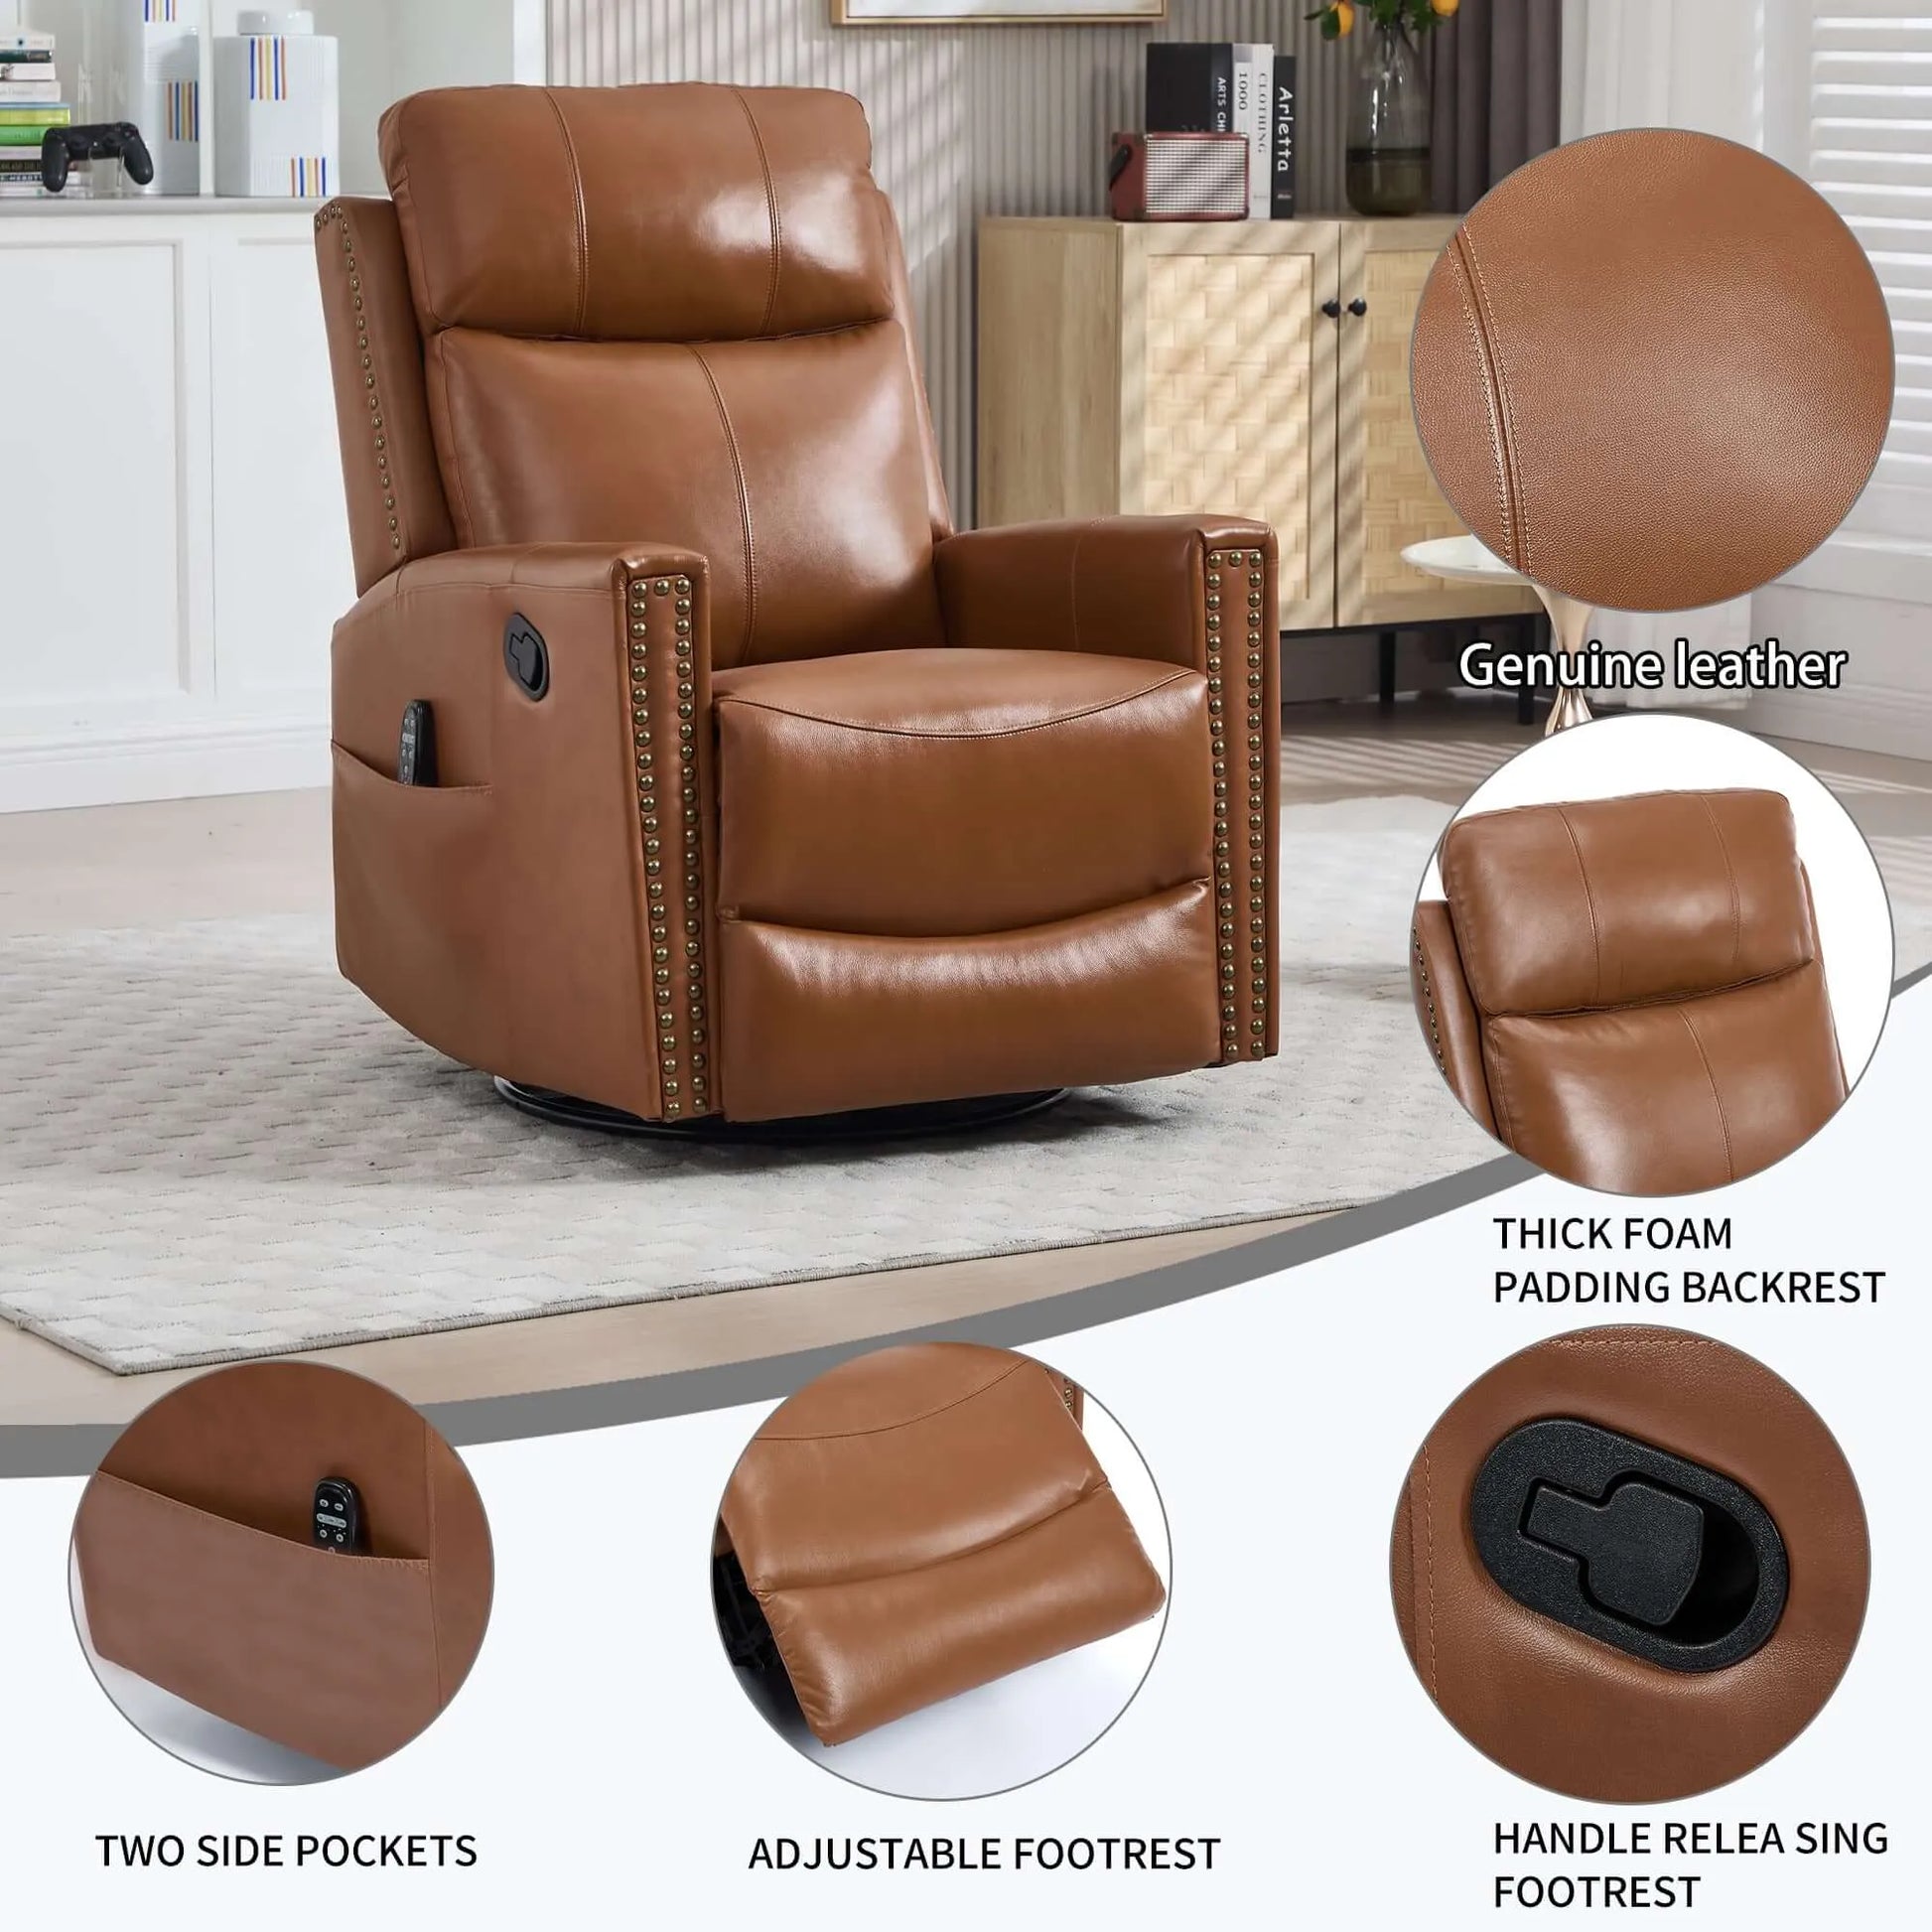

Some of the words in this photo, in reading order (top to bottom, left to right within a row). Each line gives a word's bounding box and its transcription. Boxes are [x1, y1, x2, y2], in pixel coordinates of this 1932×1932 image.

[1217, 76, 1227, 106] ARTS
[1238, 72, 1248, 110] 1000
[1258, 72, 1268, 153] CLOTHING
[1277, 86, 1294, 172] Arletta
